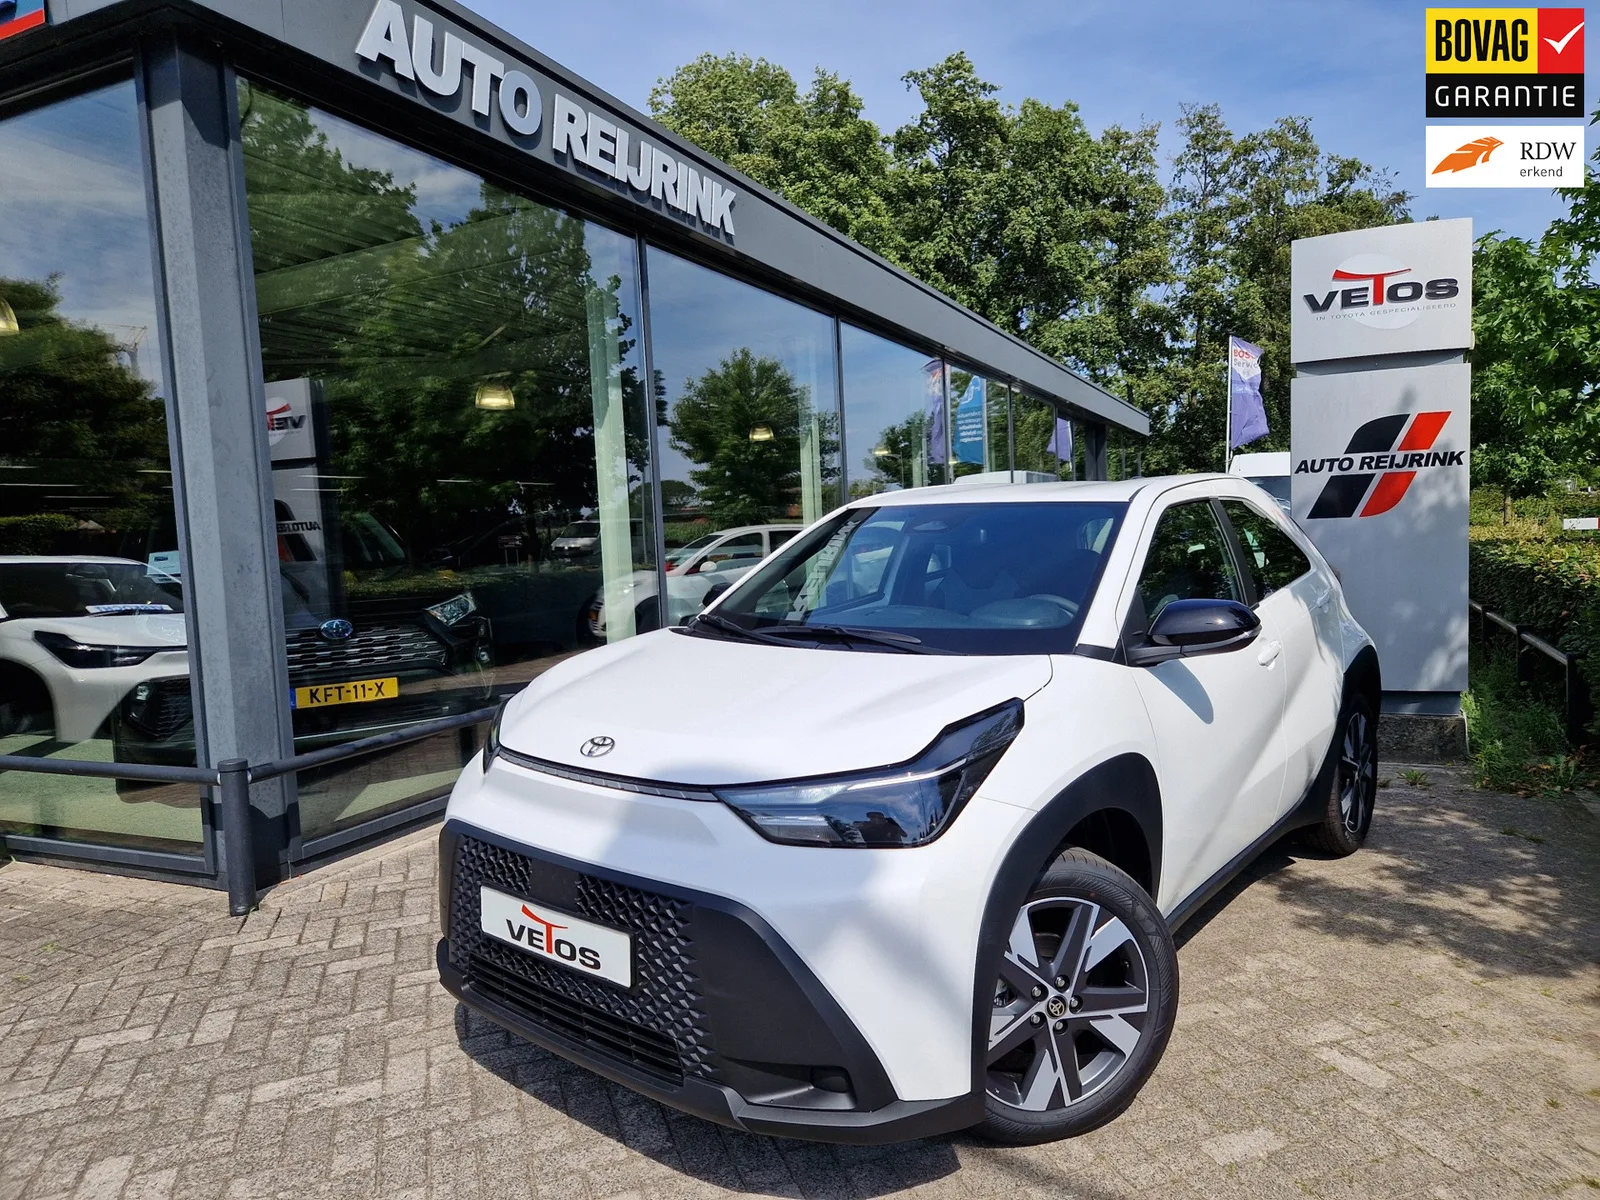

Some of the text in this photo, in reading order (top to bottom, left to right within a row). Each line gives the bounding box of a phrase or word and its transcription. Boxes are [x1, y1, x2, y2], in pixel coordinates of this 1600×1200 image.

[355, 0, 737, 236] AUTO REIJRINK
[1303, 268, 1459, 314] VETOS
[1331, 311, 1366, 320] TOYOTA
[1369, 303, 1457, 316] GESPECIALISEERD
[1233, 348, 1256, 360] BOS
[1233, 359, 1258, 369] Servic
[1294, 450, 1466, 475] AUTO REIJRINK
[309, 681, 385, 704] KFT-11-X
[505, 903, 602, 970] VETOS
